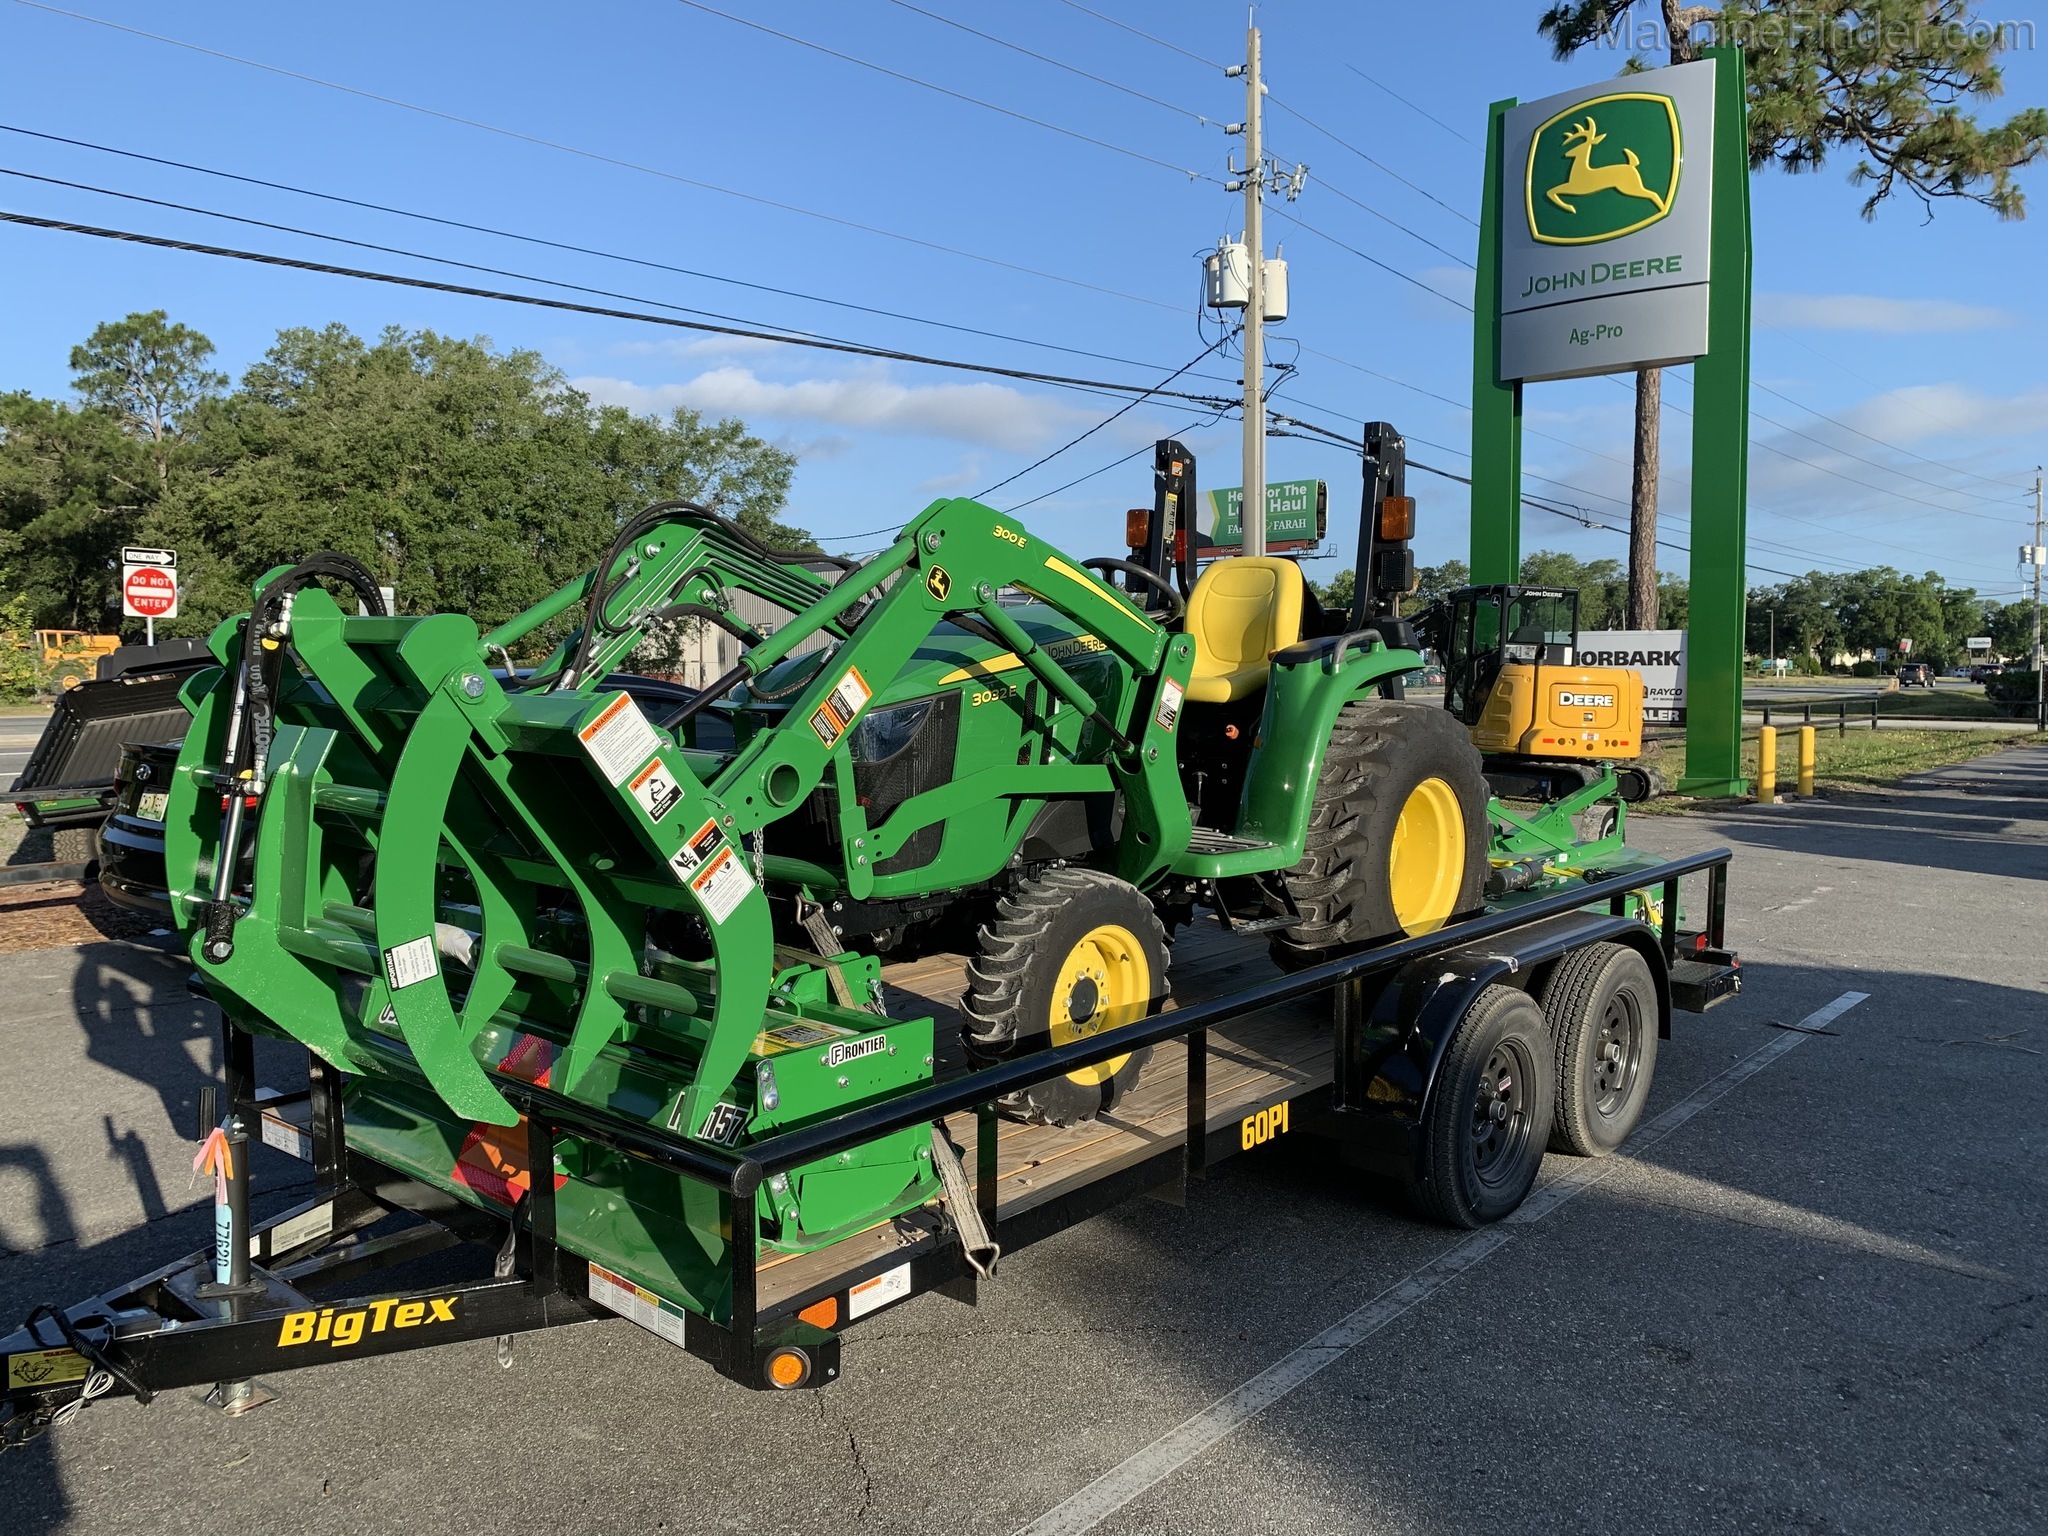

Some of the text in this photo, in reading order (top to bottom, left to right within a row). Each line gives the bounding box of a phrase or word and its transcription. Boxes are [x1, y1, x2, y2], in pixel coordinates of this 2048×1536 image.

[1521, 254, 1682, 298] JOHN DEERE
[1568, 324, 1623, 345] Ag-Pro
[1283, 484, 1308, 497] The
[1270, 495, 1307, 512] Haul
[1273, 518, 1307, 531] FARAH
[128, 552, 160, 561] ONE WAY
[132, 575, 170, 587] DO NOT
[134, 597, 168, 608] ENTER
[1073, 639, 1105, 654] DEERE
[1576, 650, 1682, 667] ORBARK
[972, 684, 1017, 707] 3032E
[1559, 691, 1615, 708] DEERE
[1650, 688, 1683, 696] RAYCO
[594, 703, 621, 730] WARNING
[638, 761, 660, 785] WARNING
[702, 851, 729, 882] WARNING
[385, 952, 399, 988] IMPORTANT
[831, 1036, 885, 1065] FRONTIER
[1241, 1100, 1290, 1151] 60PI
[215, 1221, 231, 1267] 77620
[277, 1296, 459, 1348] BigTex
